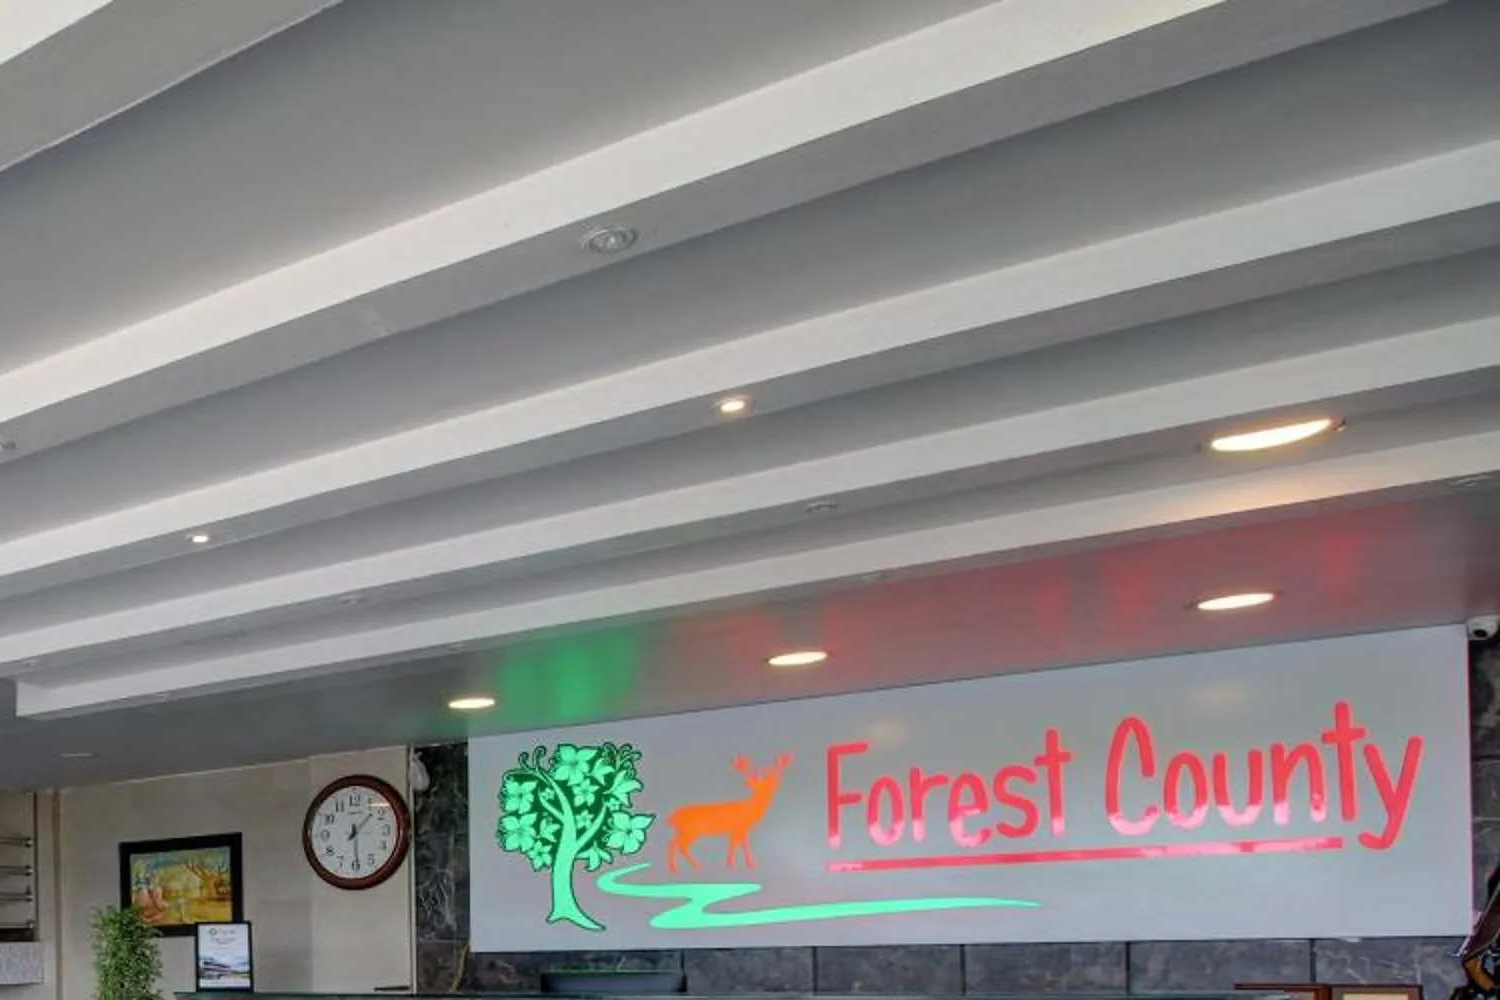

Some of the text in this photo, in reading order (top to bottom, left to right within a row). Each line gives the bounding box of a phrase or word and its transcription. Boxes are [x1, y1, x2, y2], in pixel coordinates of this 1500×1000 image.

[827, 700, 1423, 850] Forest County
[335, 800, 345, 813] 11
[348, 793, 362, 808] 12
[376, 806, 386, 821] 2
[320, 828, 331, 842] 9
[381, 823, 391, 837] 3
[324, 845, 336, 858] 8
[335, 855, 345, 869] 7
[366, 852, 377, 868] 5
